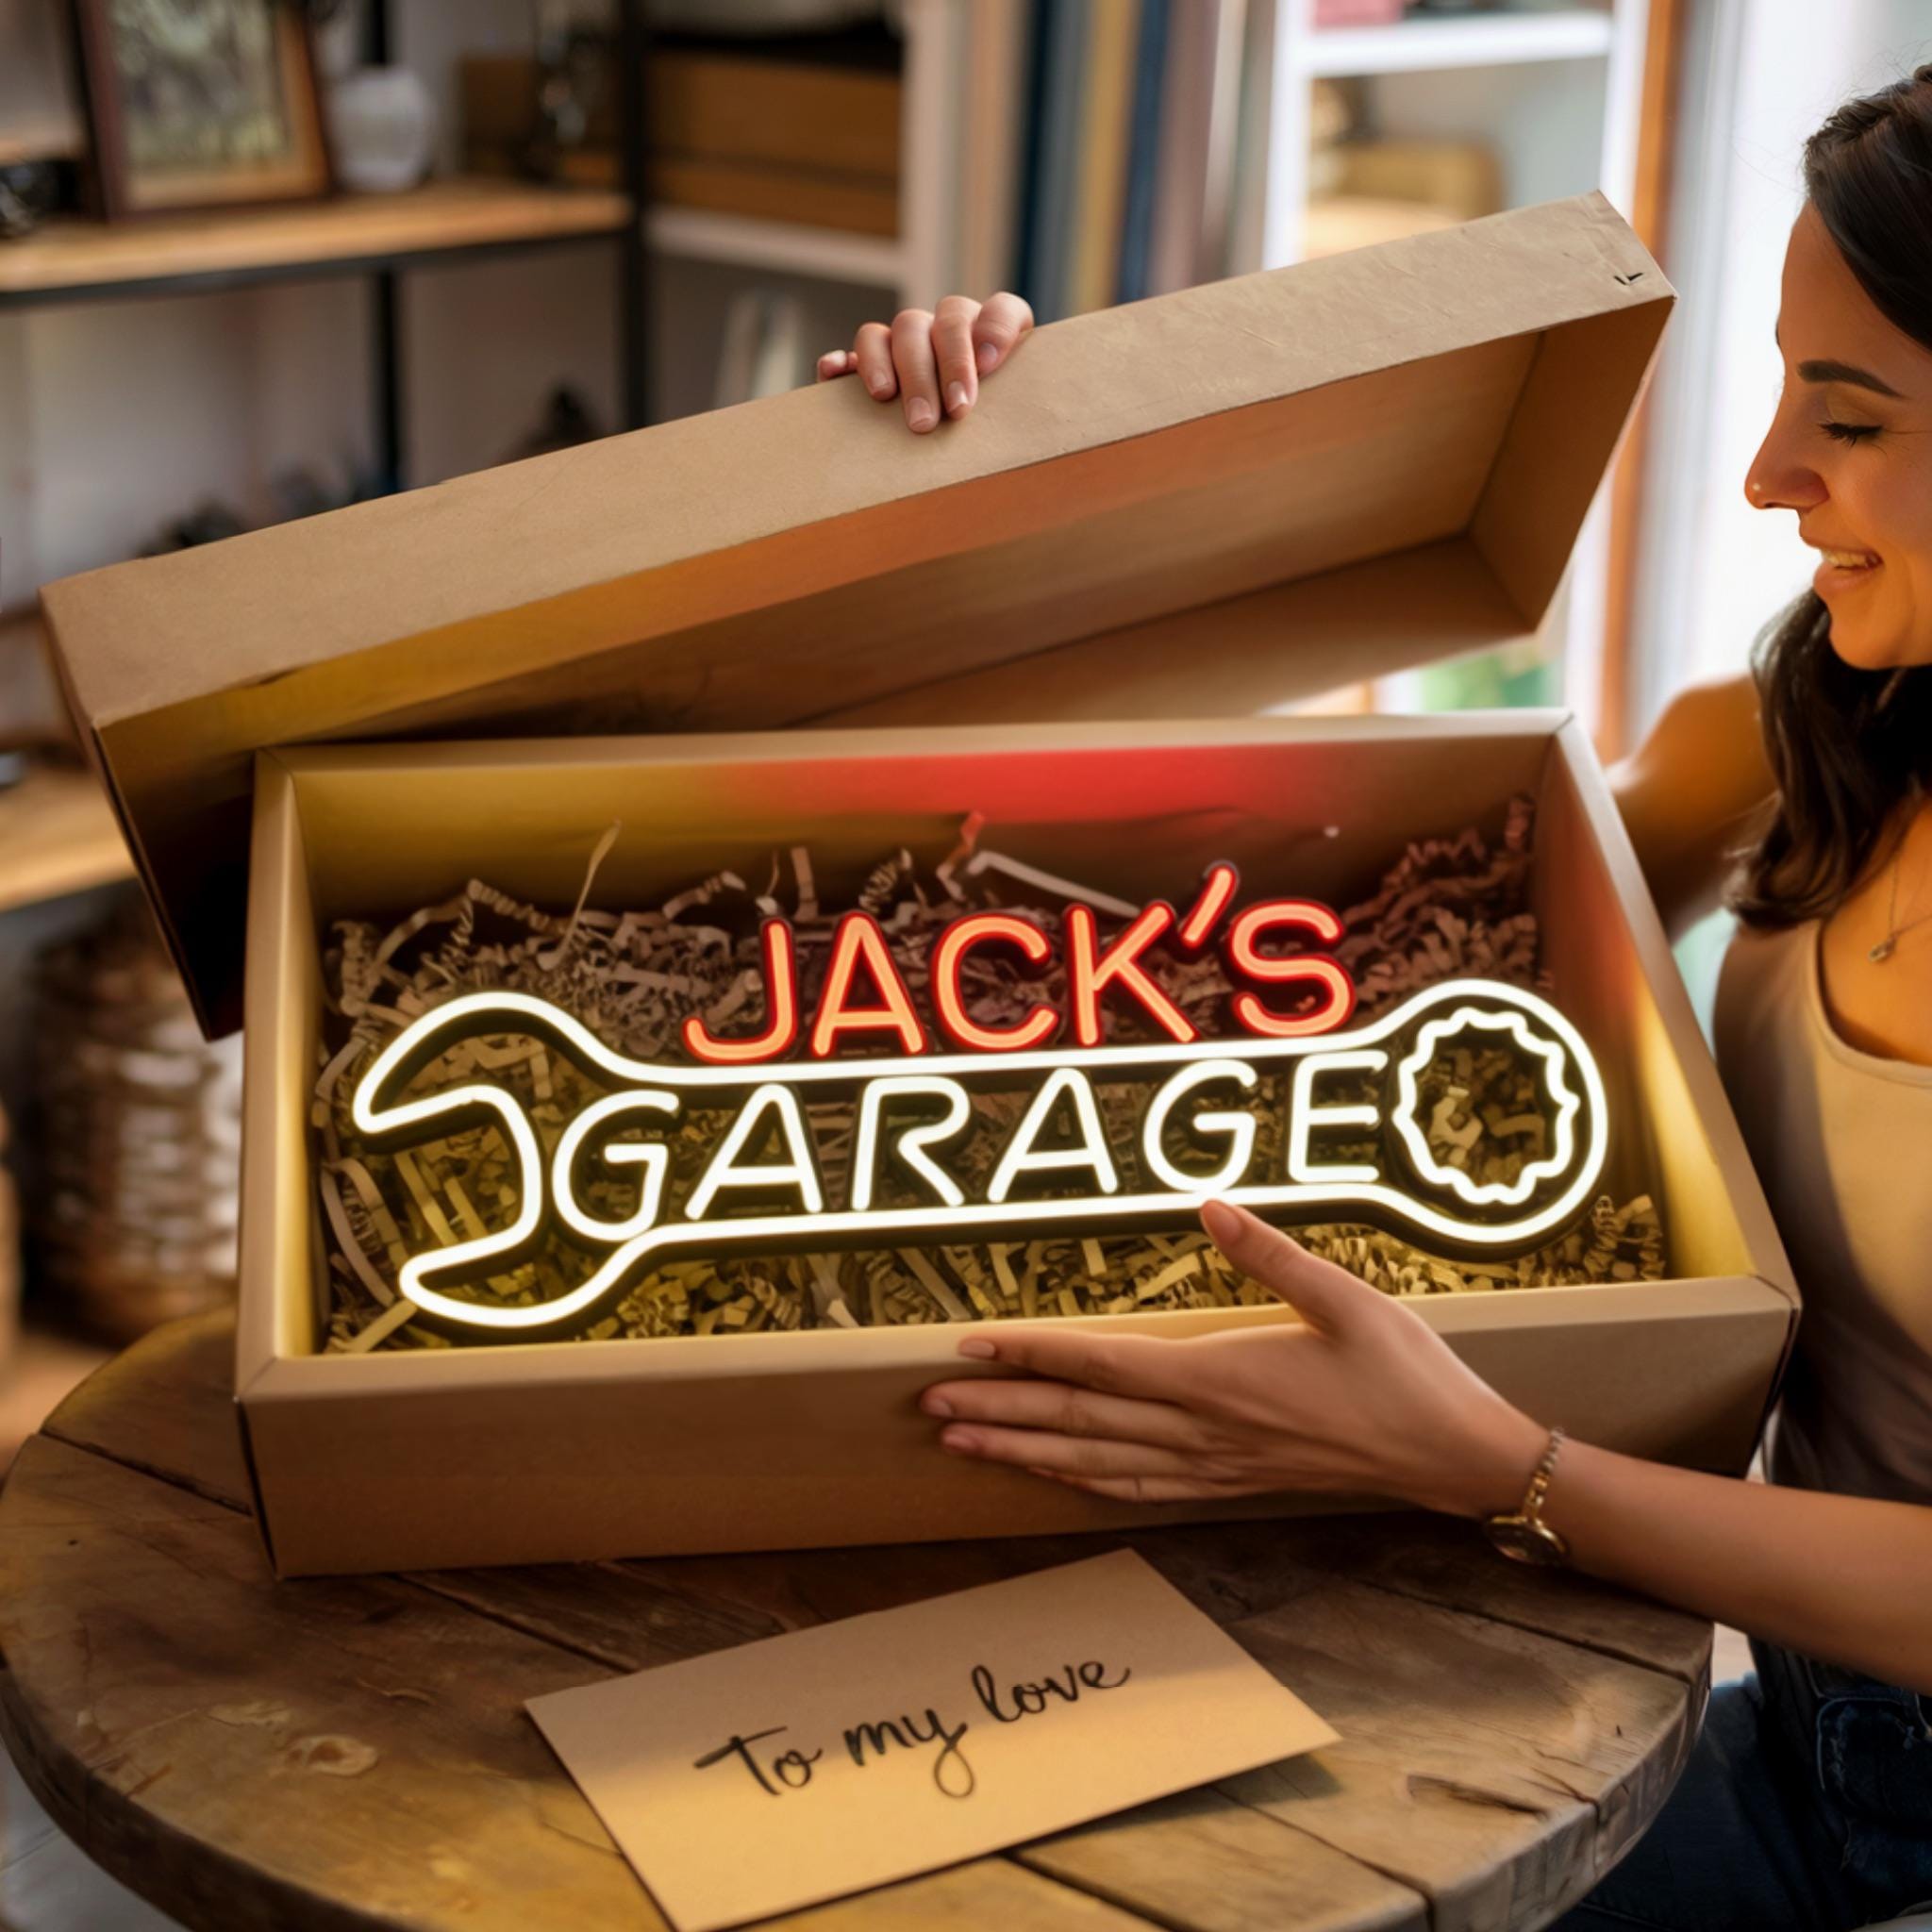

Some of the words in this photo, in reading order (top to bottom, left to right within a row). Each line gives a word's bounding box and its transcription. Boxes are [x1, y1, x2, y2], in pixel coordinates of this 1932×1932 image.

[685, 864, 1356, 1063] JACK'S
[552, 1048, 1390, 1242] GARAGE
[693, 1725, 824, 1796] To
[843, 1707, 974, 1799] my
[970, 1660, 1131, 1724] love
